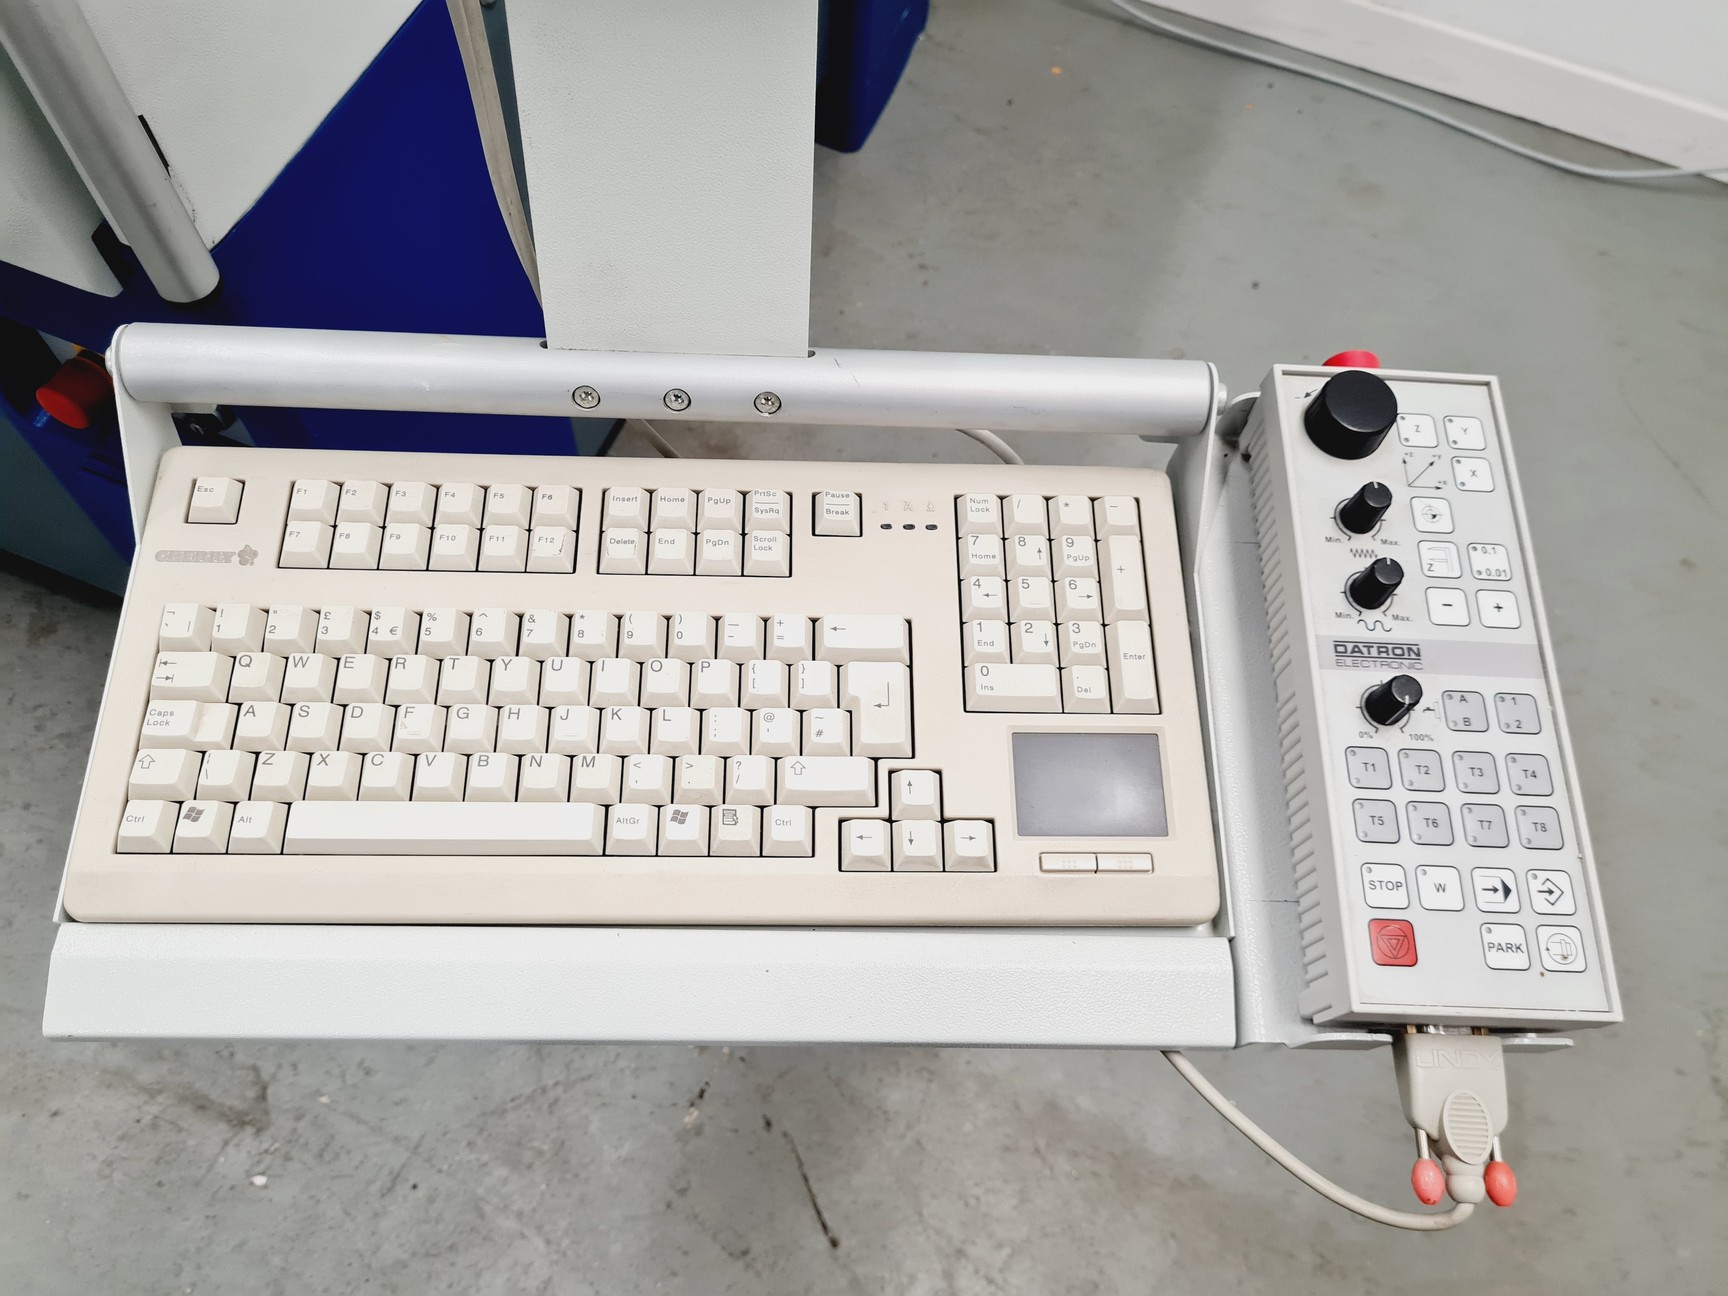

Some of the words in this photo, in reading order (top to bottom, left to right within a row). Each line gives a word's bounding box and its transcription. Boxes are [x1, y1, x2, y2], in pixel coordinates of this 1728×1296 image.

[708, 497, 731, 505] PgUp
[1016, 499, 1021, 508] /
[609, 537, 635, 545] Delete
[706, 539, 729, 547] PgDn
[971, 536, 979, 545] 7
[1018, 537, 1026, 546] 8
[1066, 537, 1074, 547] 9
[1380, 538, 1401, 546] Max.
[1482, 546, 1495, 554] 0.1
[1067, 554, 1089, 562] PgUp
[1427, 563, 1434, 572] Z
[1485, 568, 1507, 577] 0.01
[973, 578, 981, 588] 4
[1022, 579, 1029, 589] 5
[1069, 580, 1077, 590] 6
[219, 609, 224, 617] !
[1494, 604, 1503, 612] +
[324, 612, 331, 620] £
[374, 611, 381, 620] $
[427, 613, 437, 621] %
[528, 614, 536, 623] &
[628, 614, 633, 624] (
[678, 614, 683, 624] )
[216, 624, 221, 632] 1
[269, 625, 276, 633] 2
[321, 626, 328, 634] 3
[390, 626, 398, 635] €
[425, 628, 431, 636] 5
[476, 628, 482, 636] 6
[976, 622, 983, 632] 1
[1025, 623, 1033, 633] 2
[1072, 623, 1080, 633] 3
[527, 629, 533, 637] 7
[578, 630, 584, 638] 8
[627, 631, 633, 639] 9
[677, 631, 683, 639] 0
[1073, 641, 1096, 649] PgDn
[1333, 643, 1421, 657] DATRON
[239, 655, 252, 667] Q
[293, 656, 309, 668] W
[344, 656, 355, 668] E
[395, 657, 406, 669] R
[449, 658, 459, 670] T
[502, 659, 512, 671] Y
[552, 659, 563, 671] U
[601, 660, 605, 672] I
[651, 660, 662, 672] O
[1335, 659, 1423, 670] ELECTRONIC
[701, 661, 710, 672] P
[751, 664, 757, 674] {
[800, 664, 806, 674] }
[981, 666, 989, 676] 0
[751, 678, 756, 688] [
[799, 678, 805, 689] ]
[1460, 695, 1467, 703] A
[1510, 697, 1517, 705] 1
[149, 709, 174, 717] Caps
[244, 705, 255, 717] A
[299, 705, 310, 717] S
[351, 706, 363, 718] D
[404, 707, 415, 718] F
[457, 707, 469, 719] G
[508, 708, 520, 720] H
[560, 709, 569, 720] J
[612, 708, 621, 720] K
[663, 709, 671, 721] L
[764, 712, 775, 722] @
[1463, 717, 1471, 726] B
[1515, 720, 1522, 728] 2
[816, 729, 823, 737] #
[1359, 731, 1373, 739] 0%
[262, 753, 275, 765] Z
[317, 754, 330, 766] X
[371, 754, 384, 766] C
[426, 754, 436, 766] V
[478, 755, 489, 767] B
[530, 755, 542, 767] N
[581, 756, 595, 767] M
[735, 761, 742, 769] ?
[1362, 762, 1376, 772] T1
[1415, 765, 1430, 775] T2
[1469, 767, 1483, 777] T3
[1522, 769, 1537, 778] T4
[735, 775, 741, 784] /
[1369, 816, 1384, 825] T5
[1423, 818, 1438, 828] T6
[1478, 820, 1492, 829] T7
[1532, 822, 1547, 832] T8
[1369, 880, 1402, 890] STOP
[1434, 883, 1445, 892] W
[1488, 942, 1524, 953] PARK
